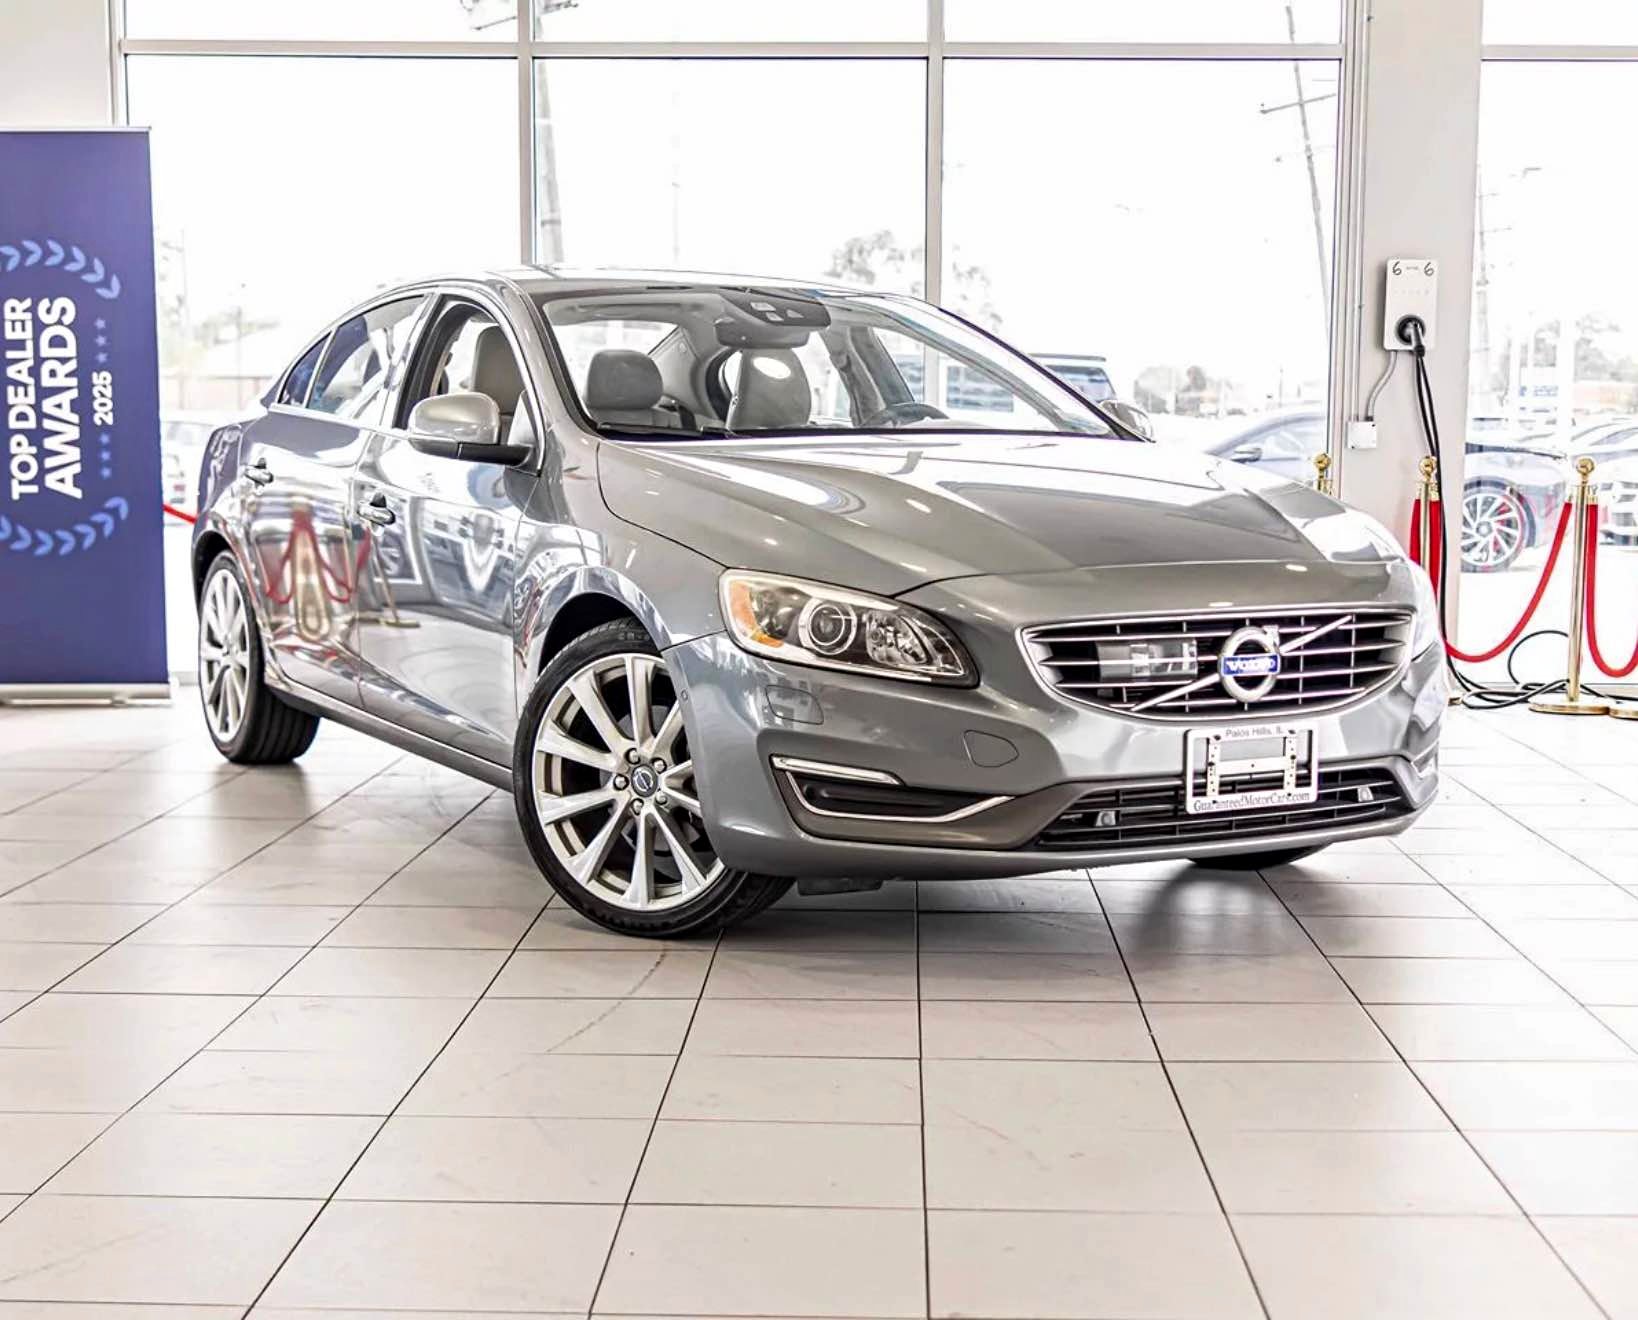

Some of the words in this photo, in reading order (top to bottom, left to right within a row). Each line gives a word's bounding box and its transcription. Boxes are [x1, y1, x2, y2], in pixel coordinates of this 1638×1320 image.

[4, 297, 37, 429] DEALER
[37, 296, 83, 499] AWARDS
[92, 370, 114, 426] 2025
[9, 433, 39, 500] TOP
[1225, 728, 1250, 738] Palos
